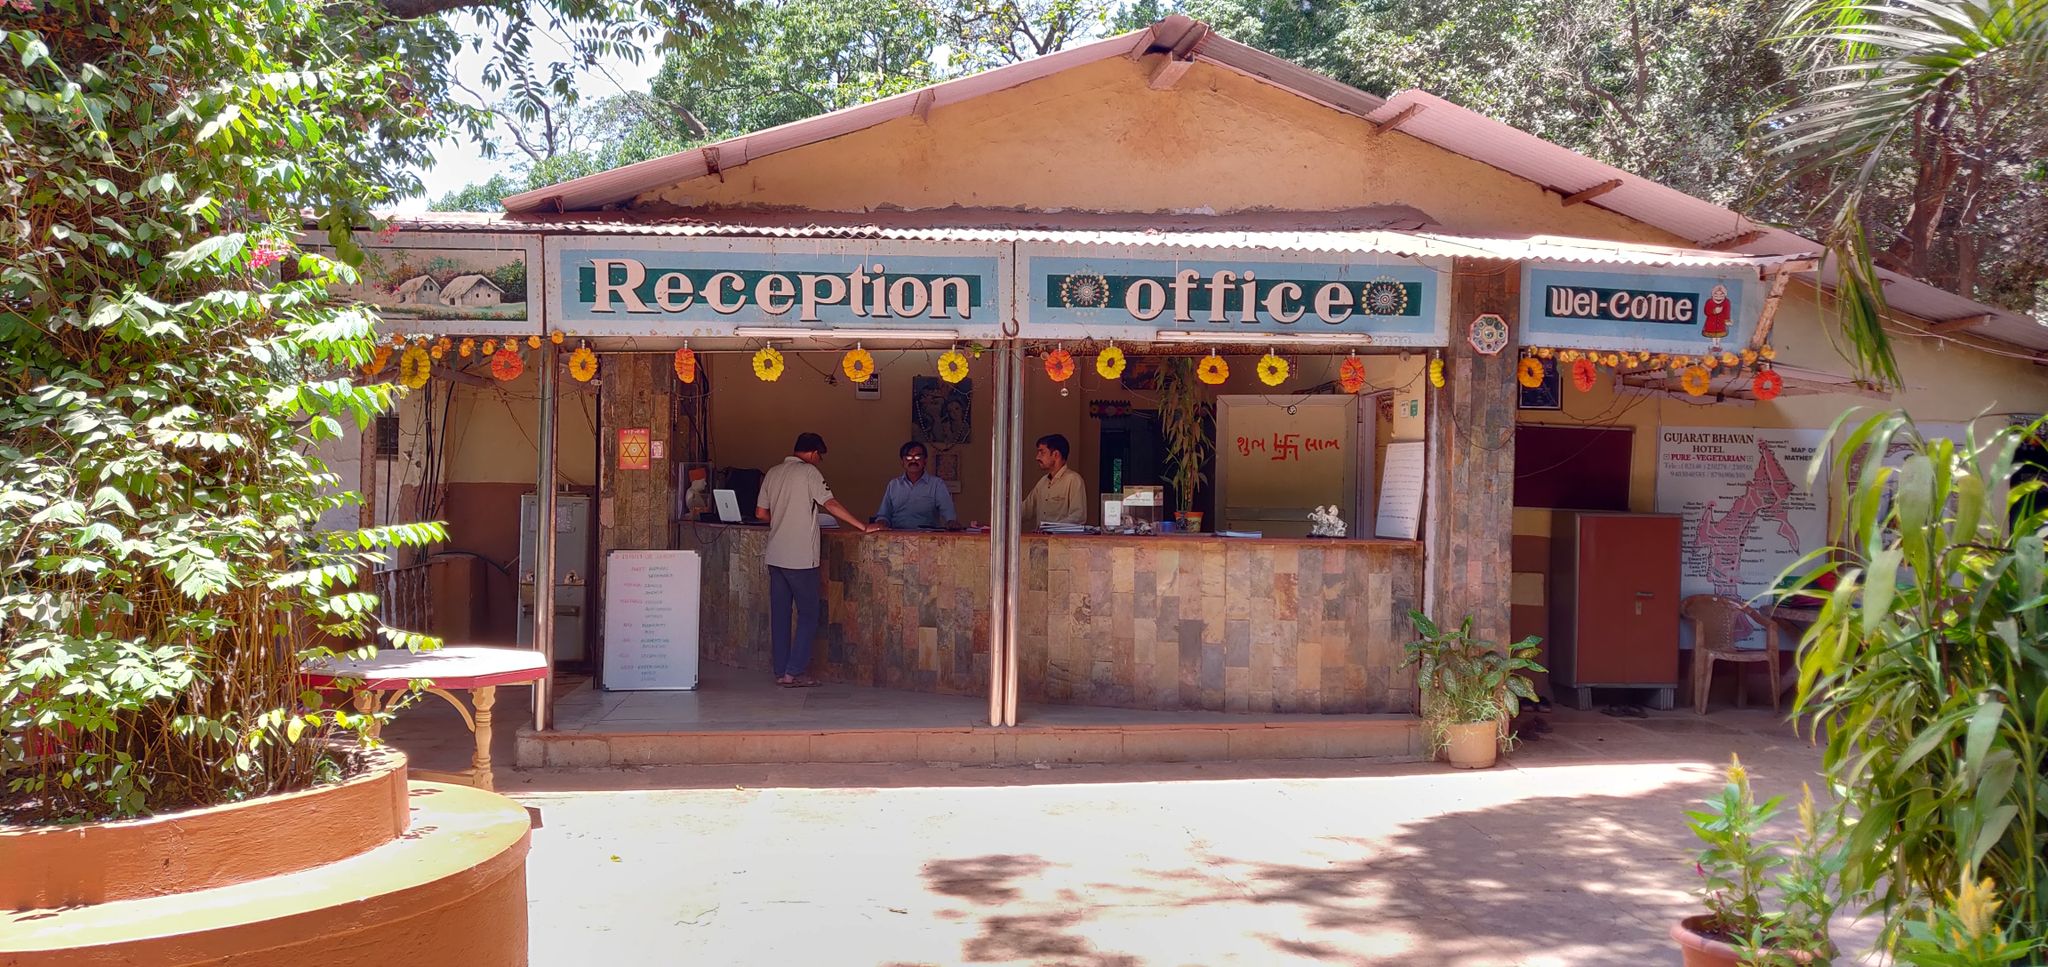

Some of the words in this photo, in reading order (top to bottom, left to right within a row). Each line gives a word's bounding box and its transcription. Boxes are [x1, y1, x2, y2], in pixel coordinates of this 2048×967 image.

[590, 257, 971, 322] Reception
[1125, 269, 1354, 324] office
[1664, 432, 1710, 444] GUJARAT
[1712, 433, 1754, 443] BHAVAN
[1236, 436, 1265, 456] શુભ
[1305, 438, 1340, 452] લાભ
[1692, 445, 1724, 453] HOTEL
[1696, 454, 1746, 462] VEGETARIAN
